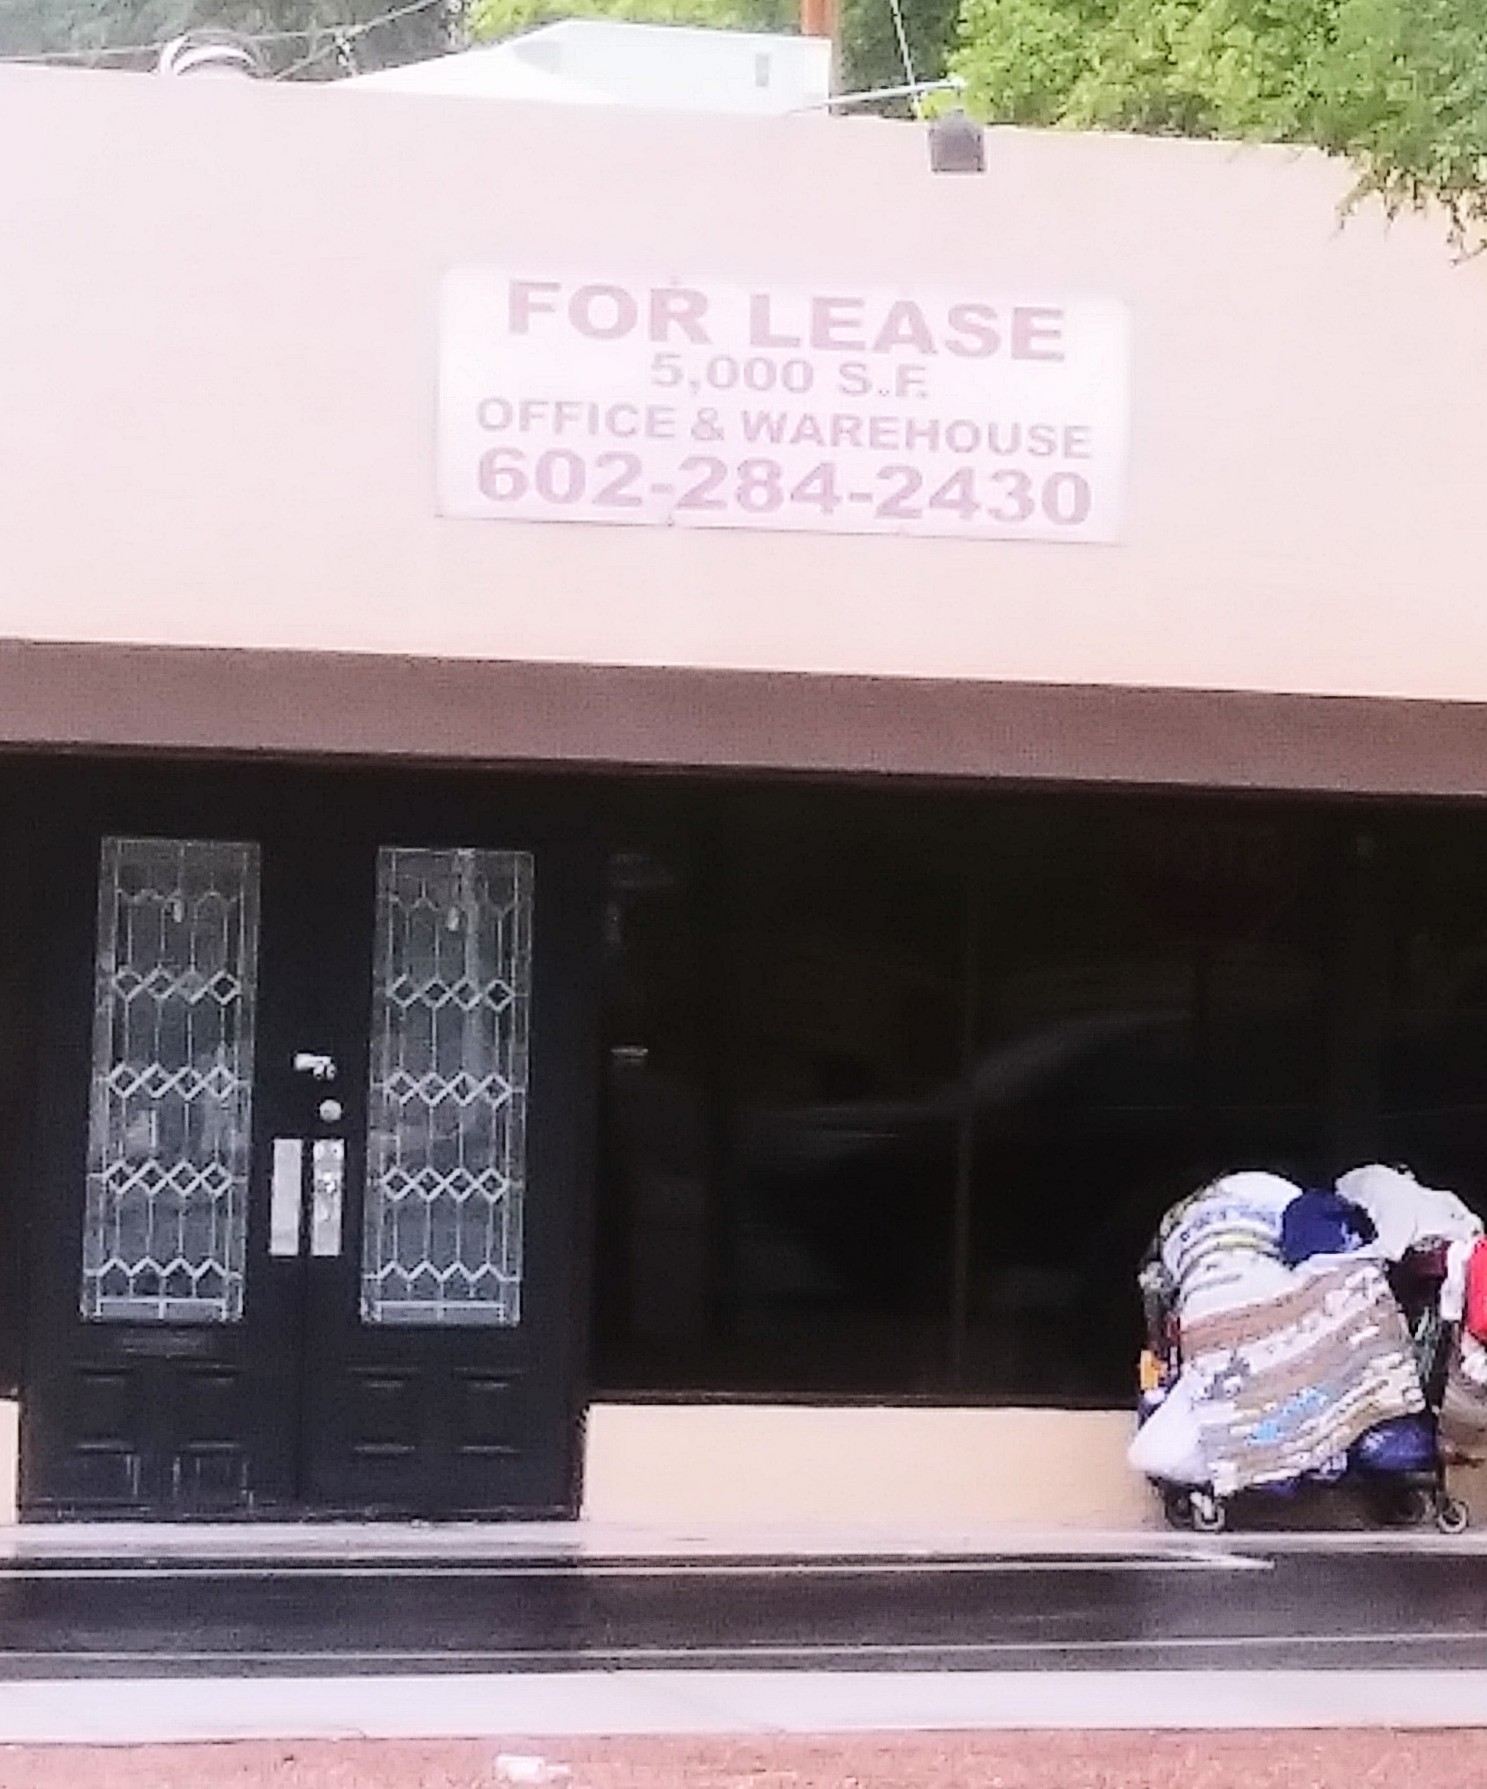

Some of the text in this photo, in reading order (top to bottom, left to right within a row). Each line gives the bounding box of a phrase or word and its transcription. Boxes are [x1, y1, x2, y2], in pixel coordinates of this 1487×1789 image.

[507, 279, 1066, 362] FOR LEASE
[650, 352, 814, 394] 5,000
[476, 396, 1093, 460] OFFICE & WAREHOUSE
[477, 448, 1092, 525] 602-284-2430
